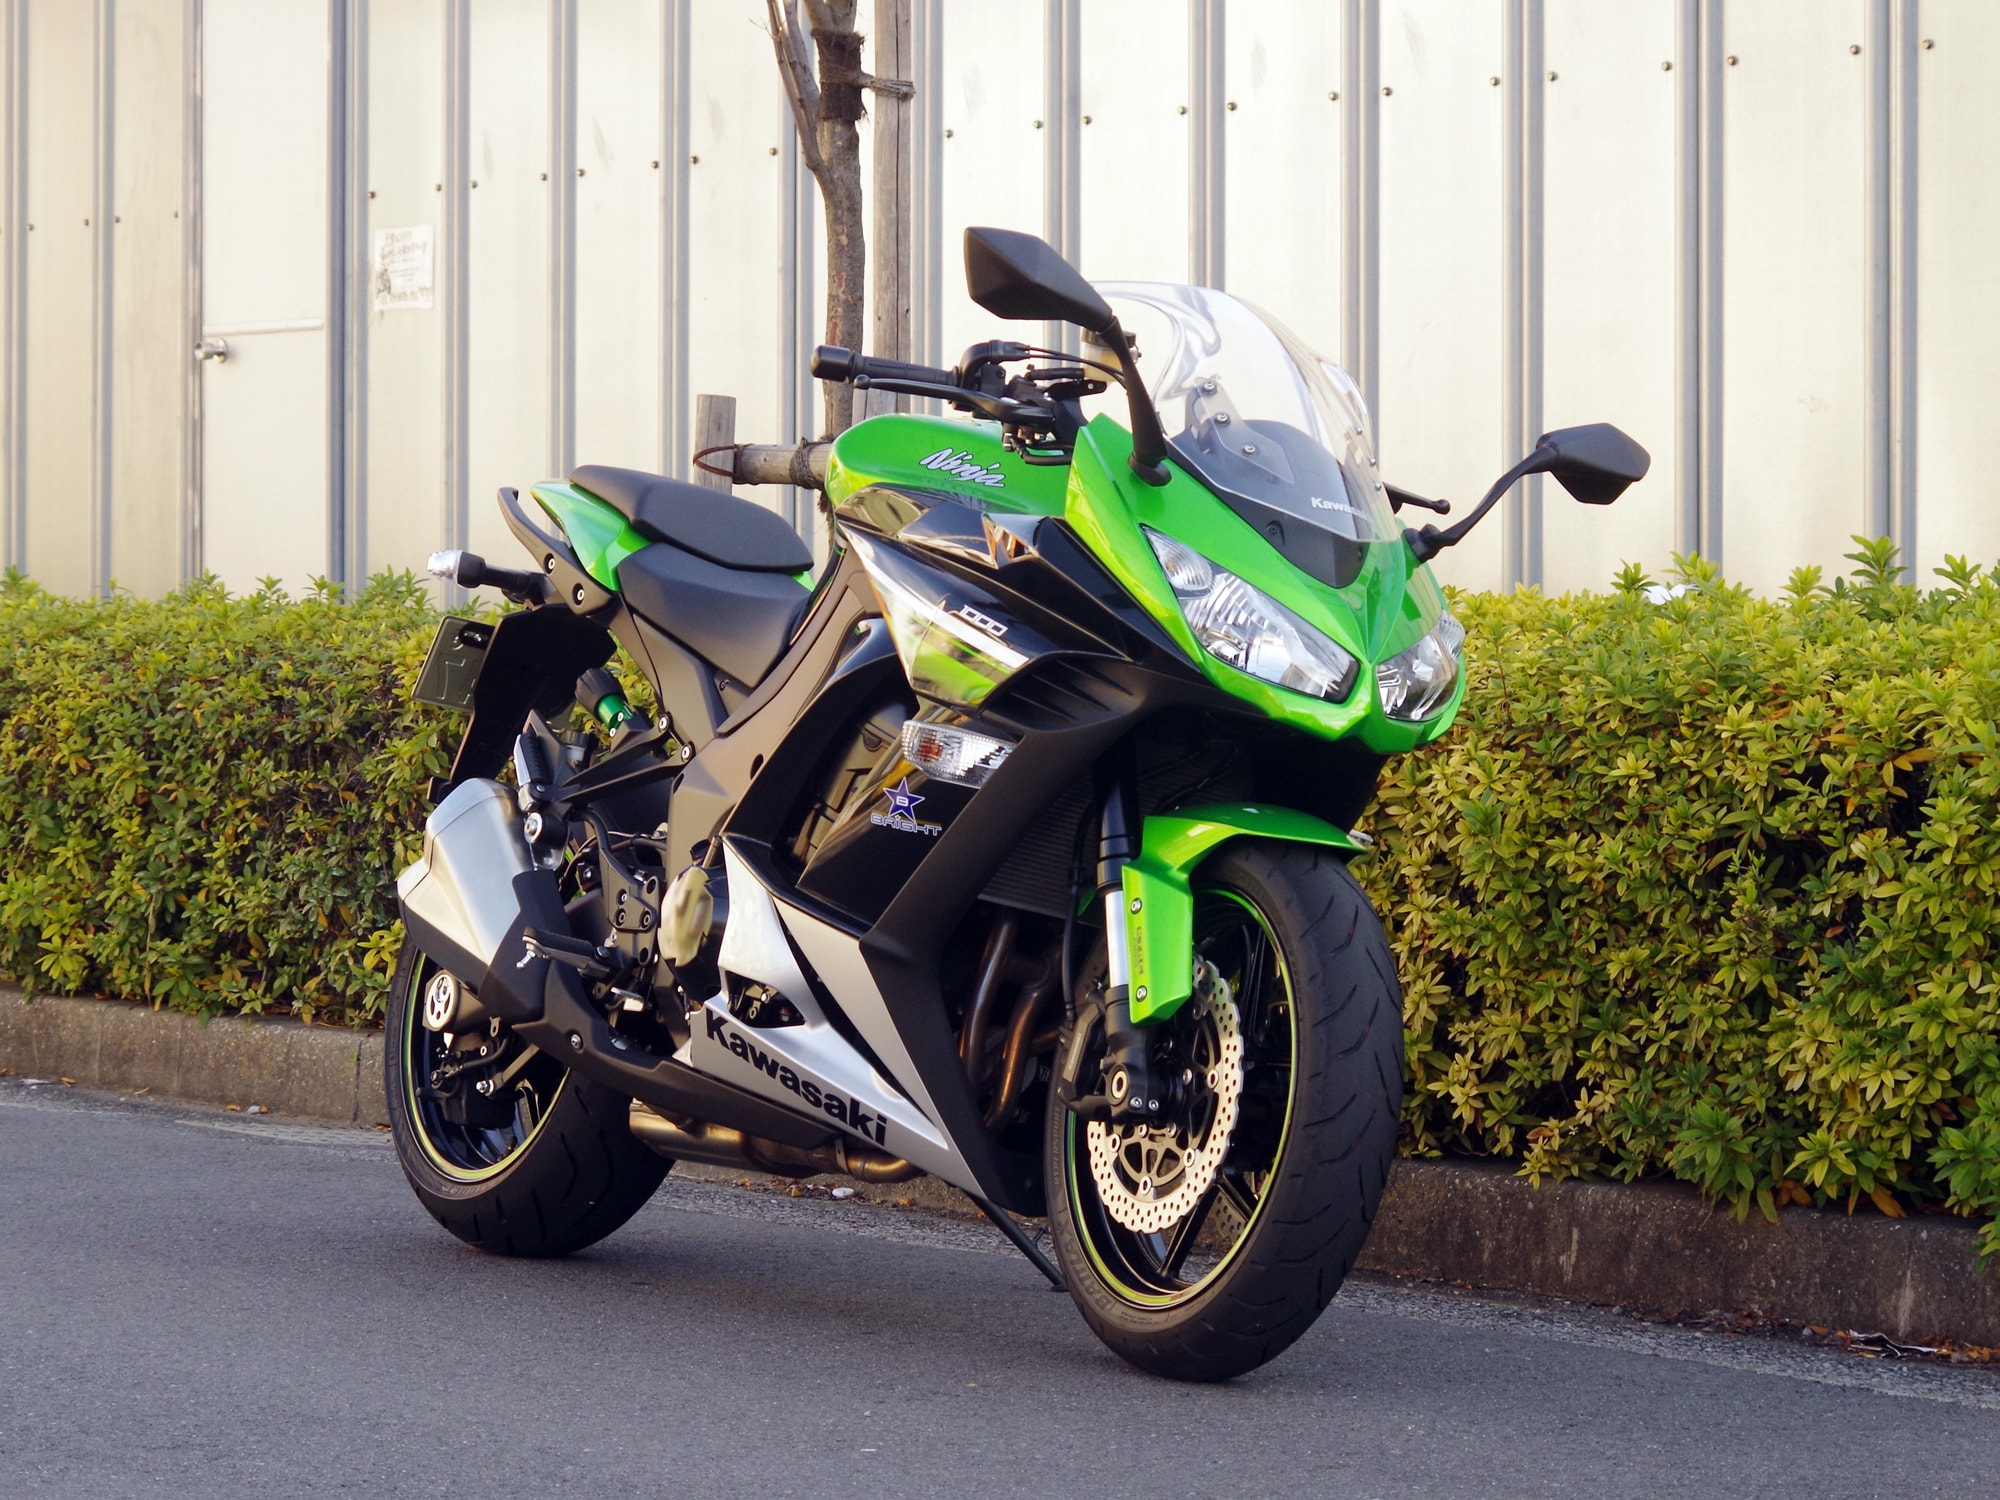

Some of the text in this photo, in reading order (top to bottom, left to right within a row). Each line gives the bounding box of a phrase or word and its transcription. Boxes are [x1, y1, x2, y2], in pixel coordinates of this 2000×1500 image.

[919, 447, 1006, 487] Ninja
[959, 604, 1008, 637] 1000
[896, 795, 909, 807] B
[705, 1006, 887, 1147] Kawasaki
